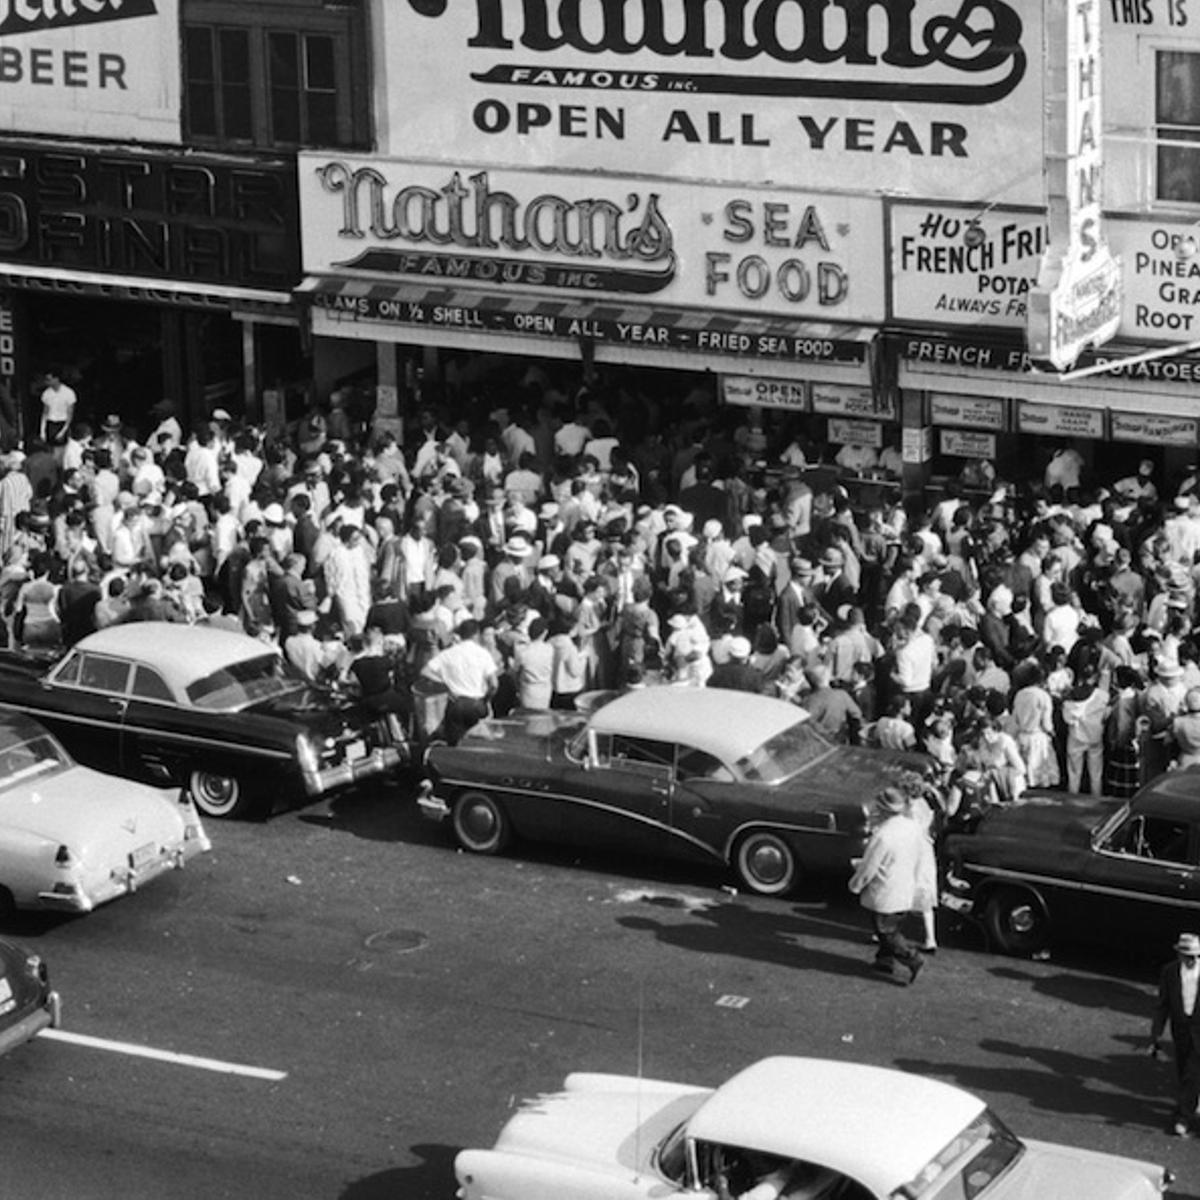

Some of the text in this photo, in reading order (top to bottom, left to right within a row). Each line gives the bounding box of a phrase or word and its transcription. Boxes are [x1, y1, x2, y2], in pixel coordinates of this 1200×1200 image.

[0, 45, 129, 90] BEER
[510, 68, 661, 91] FAMOUS
[471, 99, 969, 158] OPEN ALL YEAR
[314, 161, 674, 262] Nathan's
[723, 199, 832, 252] SEA
[400, 256, 547, 286] FAMOUS
[901, 223, 1049, 274] FRENCH FRI
[704, 251, 849, 307] FOOD
[934, 293, 1001, 315] ALWAYS
[1135, 303, 1194, 331] ROOT
[378, 300, 401, 317] ON
[433, 306, 484, 327] SHELL
[513, 314, 556, 334] OPEN
[568, 318, 605, 338] ALL
[617, 323, 670, 344] YEAR
[698, 331, 751, 352] FRIED
[757, 337, 789, 356] SEA
[794, 340, 835, 358] FOOD
[907, 340, 993, 365] FRENCH
[756, 381, 802, 397] OPEN
